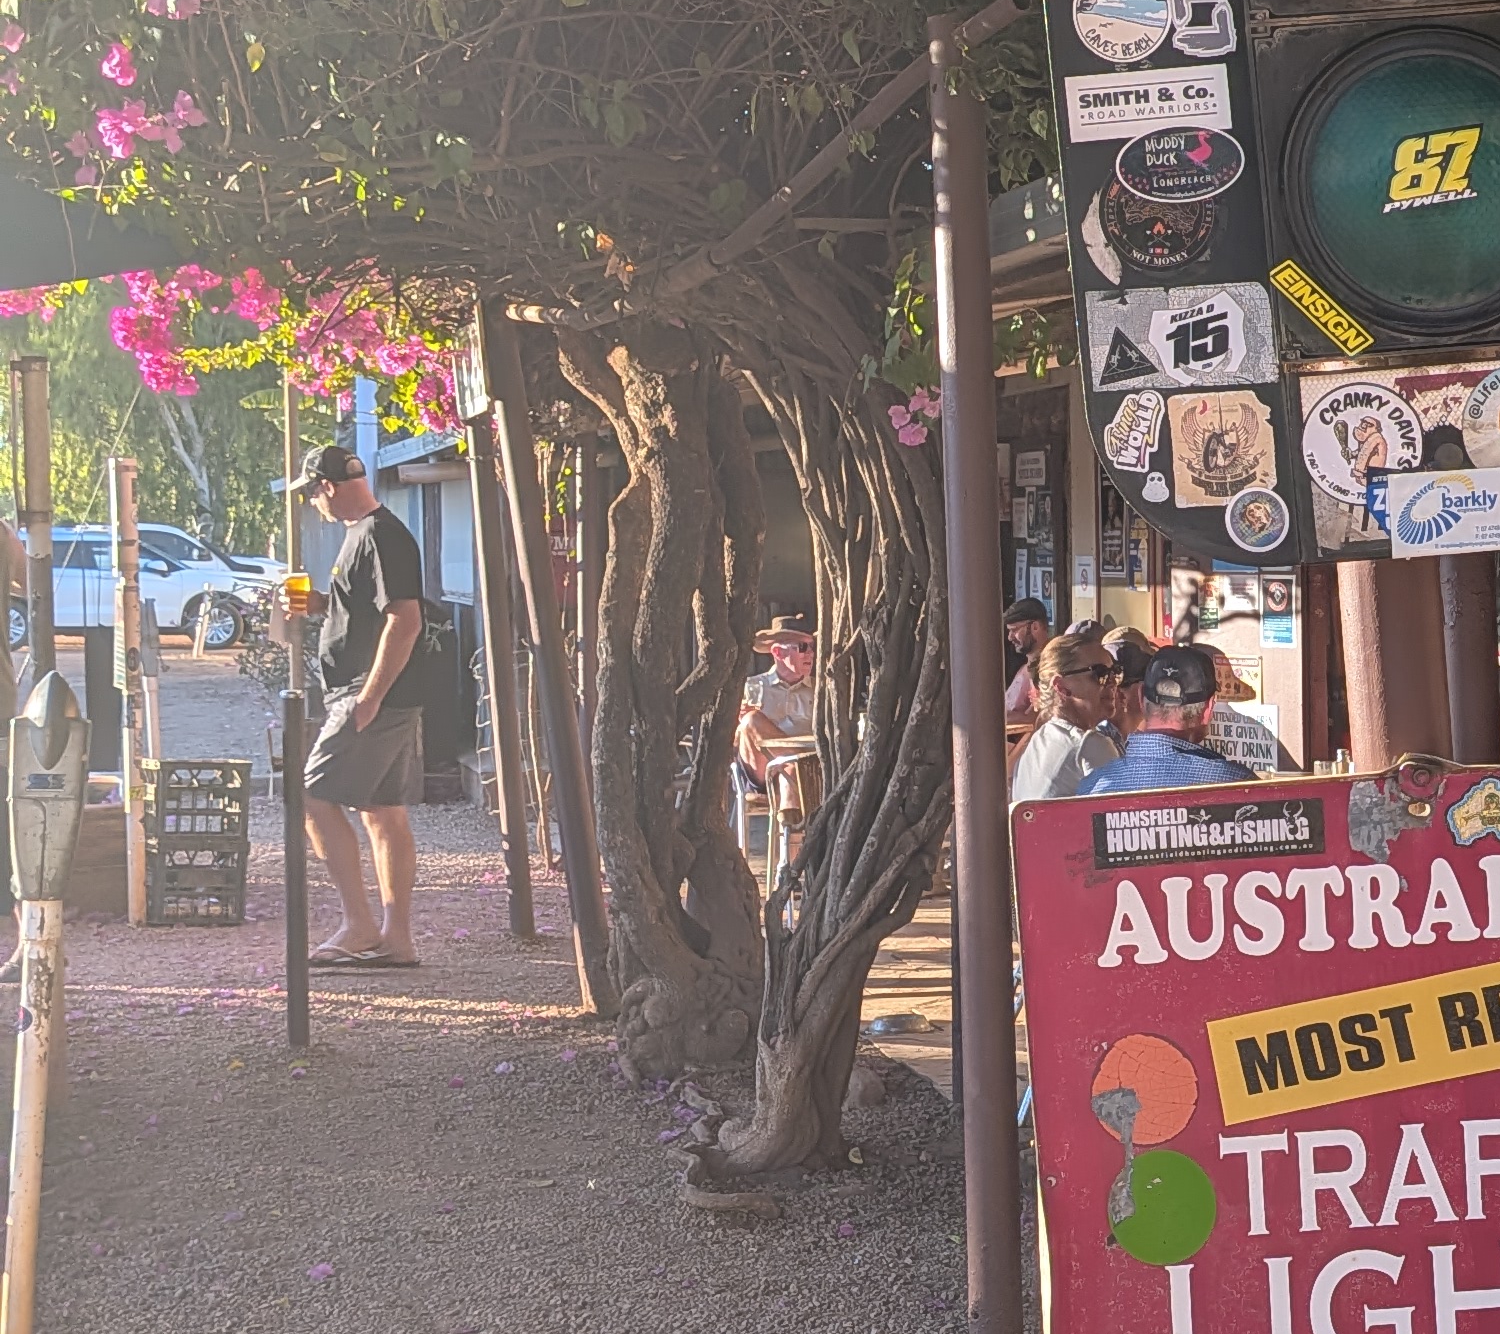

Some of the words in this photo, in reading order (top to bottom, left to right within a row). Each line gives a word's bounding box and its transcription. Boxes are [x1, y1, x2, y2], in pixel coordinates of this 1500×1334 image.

[1085, 28, 1118, 56] CAVES
[1121, 33, 1156, 56] BEACH
[1078, 89, 1150, 110] SMITH
[1157, 87, 1175, 102] &
[1182, 84, 1215, 100] Co.
[1088, 109, 1126, 121] ROAD
[1135, 102, 1210, 117] WARRIORS
[1145, 135, 1186, 153] MUDDY
[1146, 152, 1178, 166] DUCK
[1389, 127, 1481, 201] 87
[1153, 175, 1212, 188] LONGREACH
[1382, 188, 1478, 215] PYWELL
[1130, 250, 1151, 264] NOT
[1153, 250, 1189, 265] MONEY
[1170, 306, 1204, 324] KIZZA
[1206, 304, 1215, 314] D
[1275, 267, 1366, 350] EINSIGN
[1166, 311, 1230, 369] 15
[1116, 391, 1159, 466] WORLD
[1319, 392, 1390, 426] CRANKY
[1387, 405, 1418, 470] DAVE'S
[1441, 490, 1498, 510] barkly
[1224, 725, 1233, 738] BE
[1236, 725, 1258, 740] GIVEN
[1261, 729, 1273, 742] AN
[1203, 738, 1239, 756] ENERGY
[1242, 742, 1273, 760] DRINK
[1106, 807, 1188, 829] MANSFIELD
[1107, 817, 1310, 854] HUNTING&FISHING
[1236, 1010, 1417, 1096] MOST
